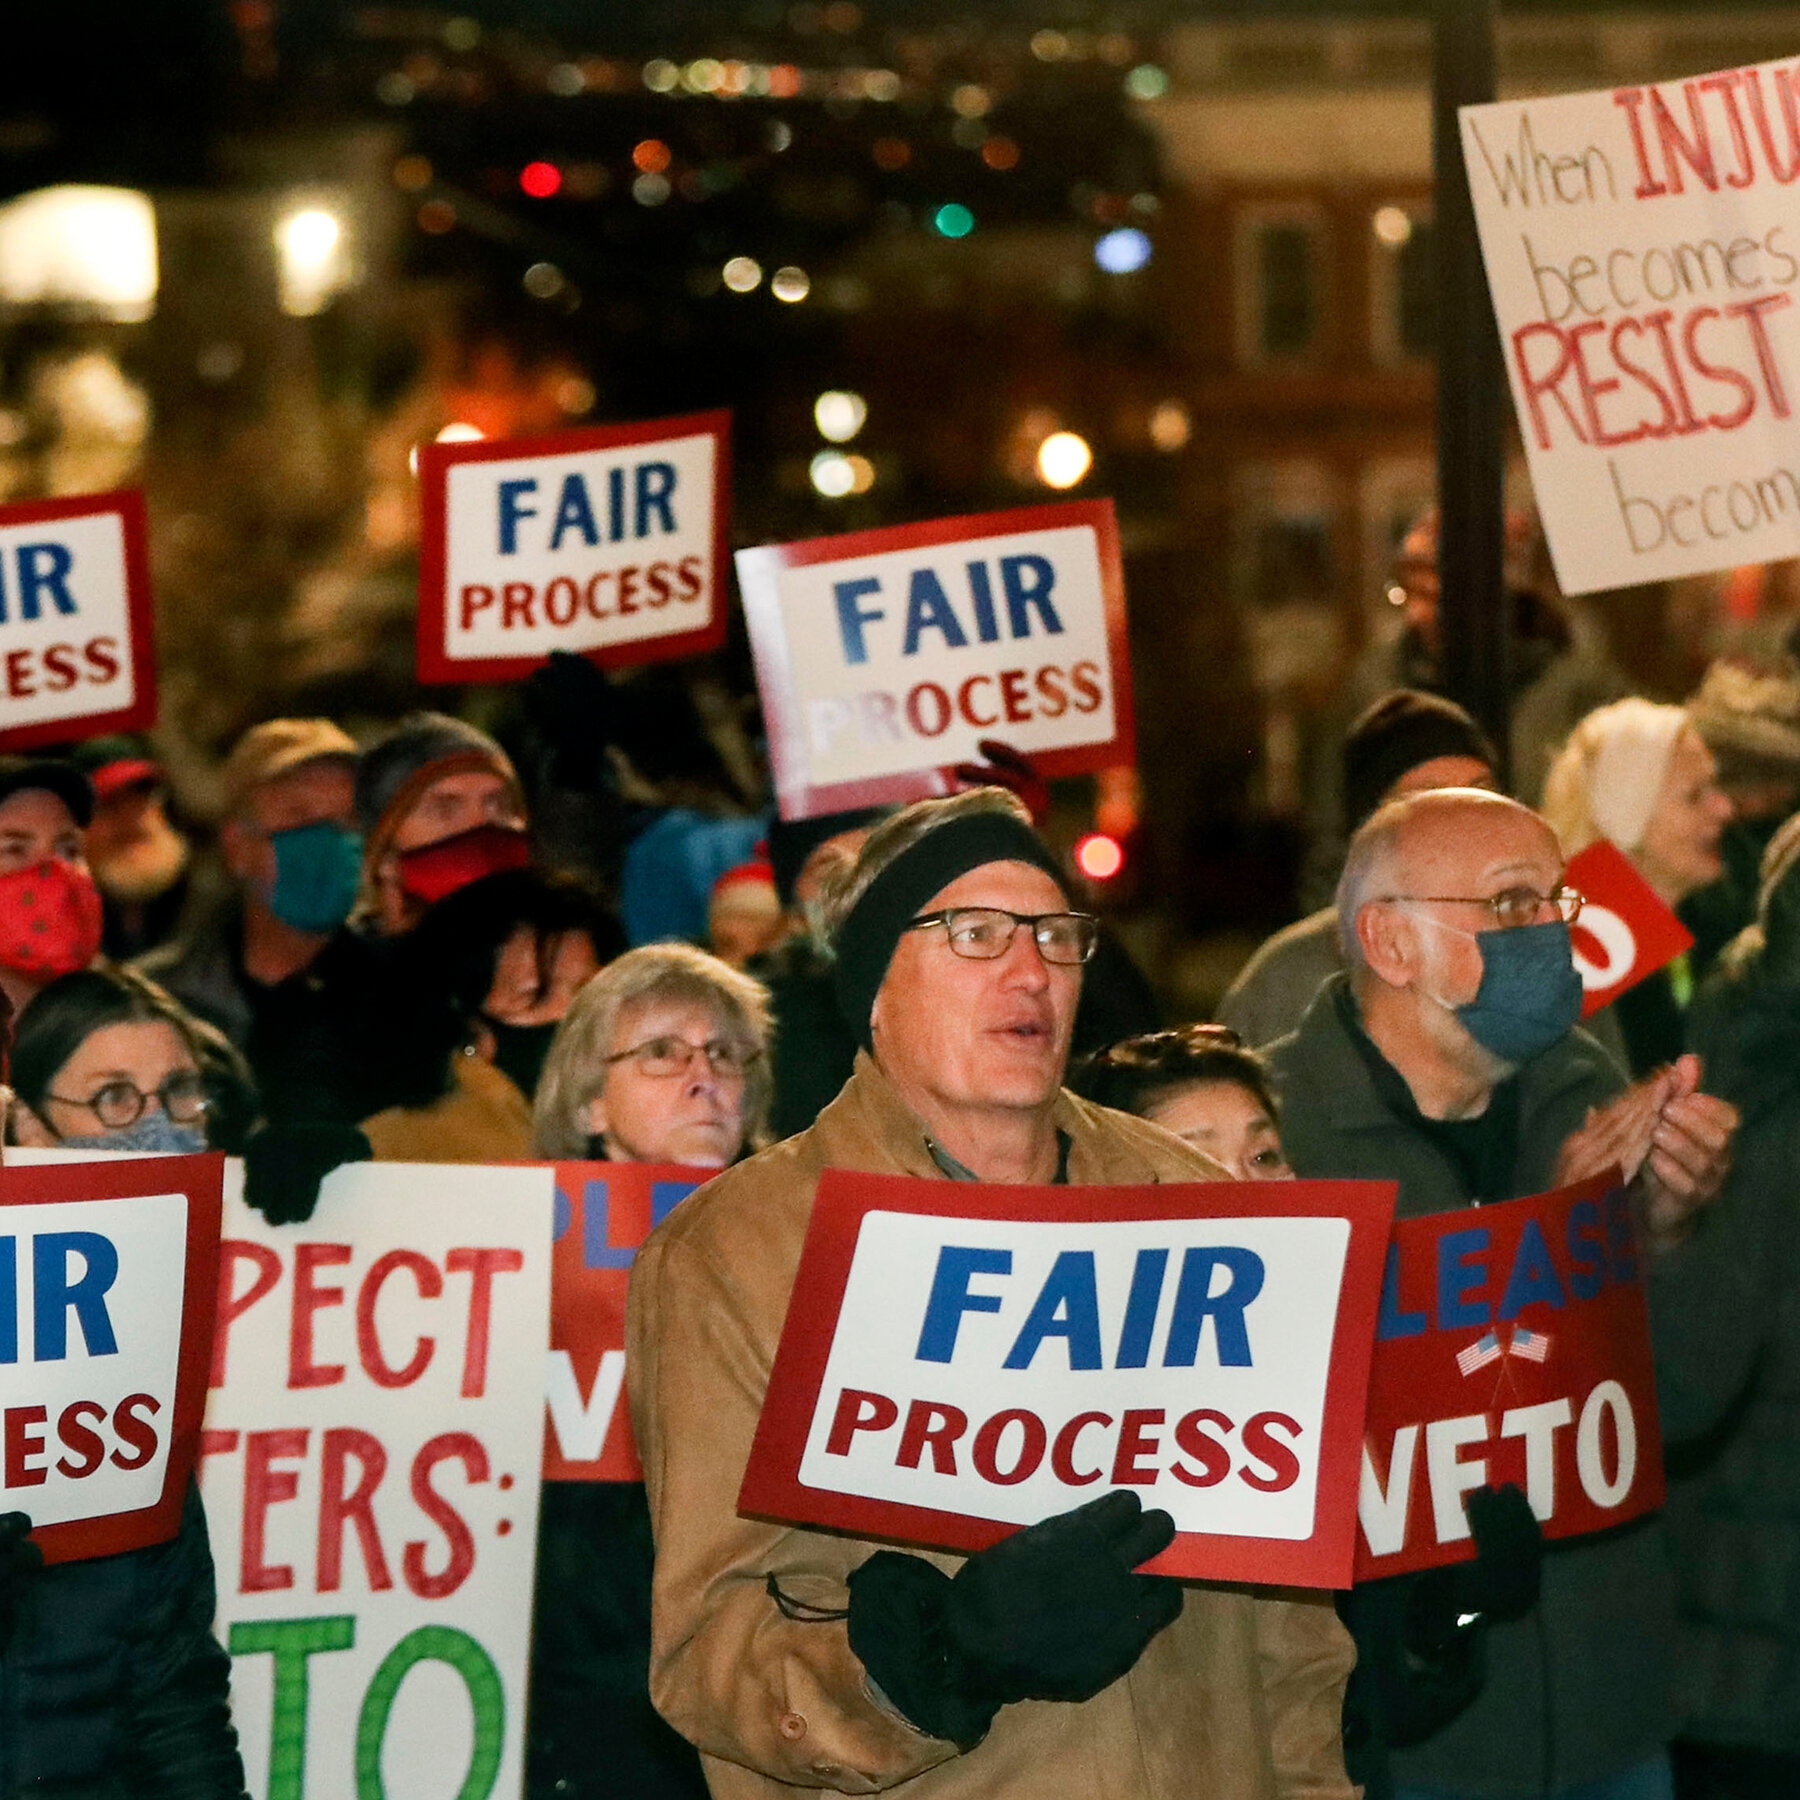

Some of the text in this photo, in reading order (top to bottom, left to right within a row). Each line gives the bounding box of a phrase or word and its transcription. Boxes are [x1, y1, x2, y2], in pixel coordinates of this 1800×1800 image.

[1469, 64, 1800, 208] When INJU
[1522, 226, 1799, 323] becomes
[1511, 292, 1792, 450] RESIST
[498, 461, 678, 555] FAIR
[460, 556, 703, 633] PROCESS
[834, 553, 1063, 666] FAIR
[6, 636, 119, 697] ESS
[808, 660, 1102, 753] PROCESS
[208, 1238, 523, 1399] PECT
[914, 1245, 1266, 1371] FAIR
[3, 1393, 162, 1489] ESS
[825, 1388, 1304, 1493] PROCESS
